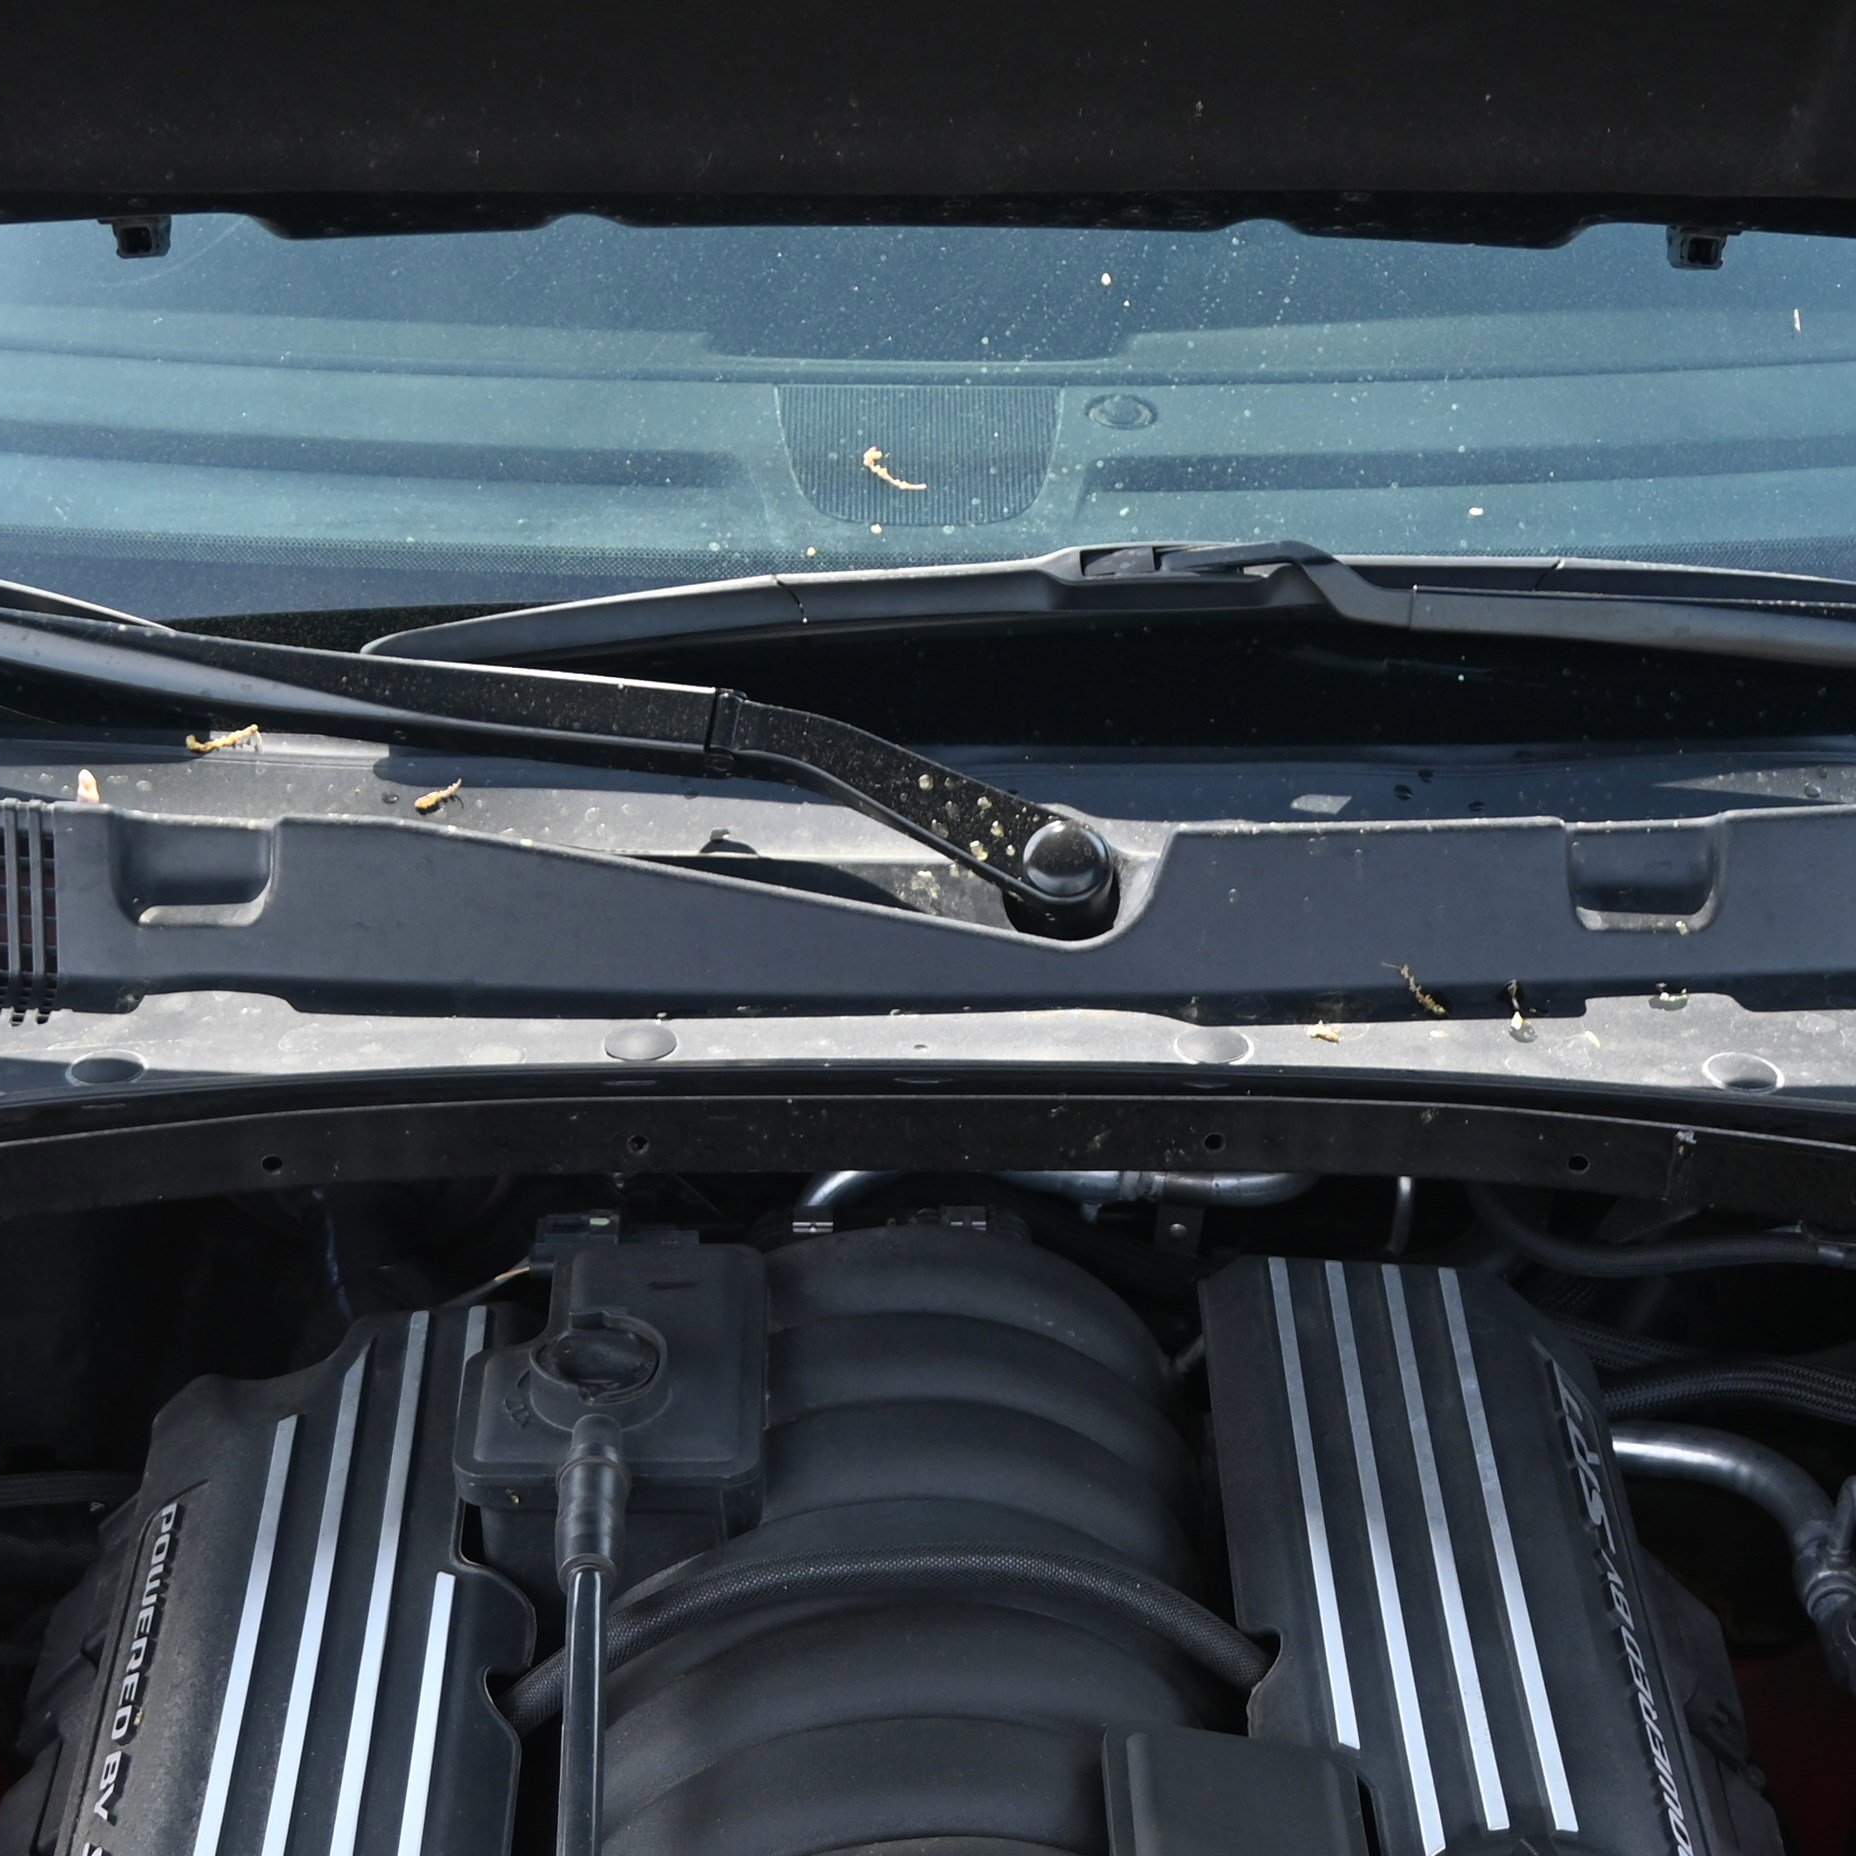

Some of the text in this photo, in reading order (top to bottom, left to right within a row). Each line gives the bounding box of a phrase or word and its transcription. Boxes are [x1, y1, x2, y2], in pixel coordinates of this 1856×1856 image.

[1546, 1357, 1616, 1554] SRT
[110, 1502, 183, 1746] POWERED
[1600, 1547, 1635, 1626] BY
[93, 1751, 126, 1820] BY
